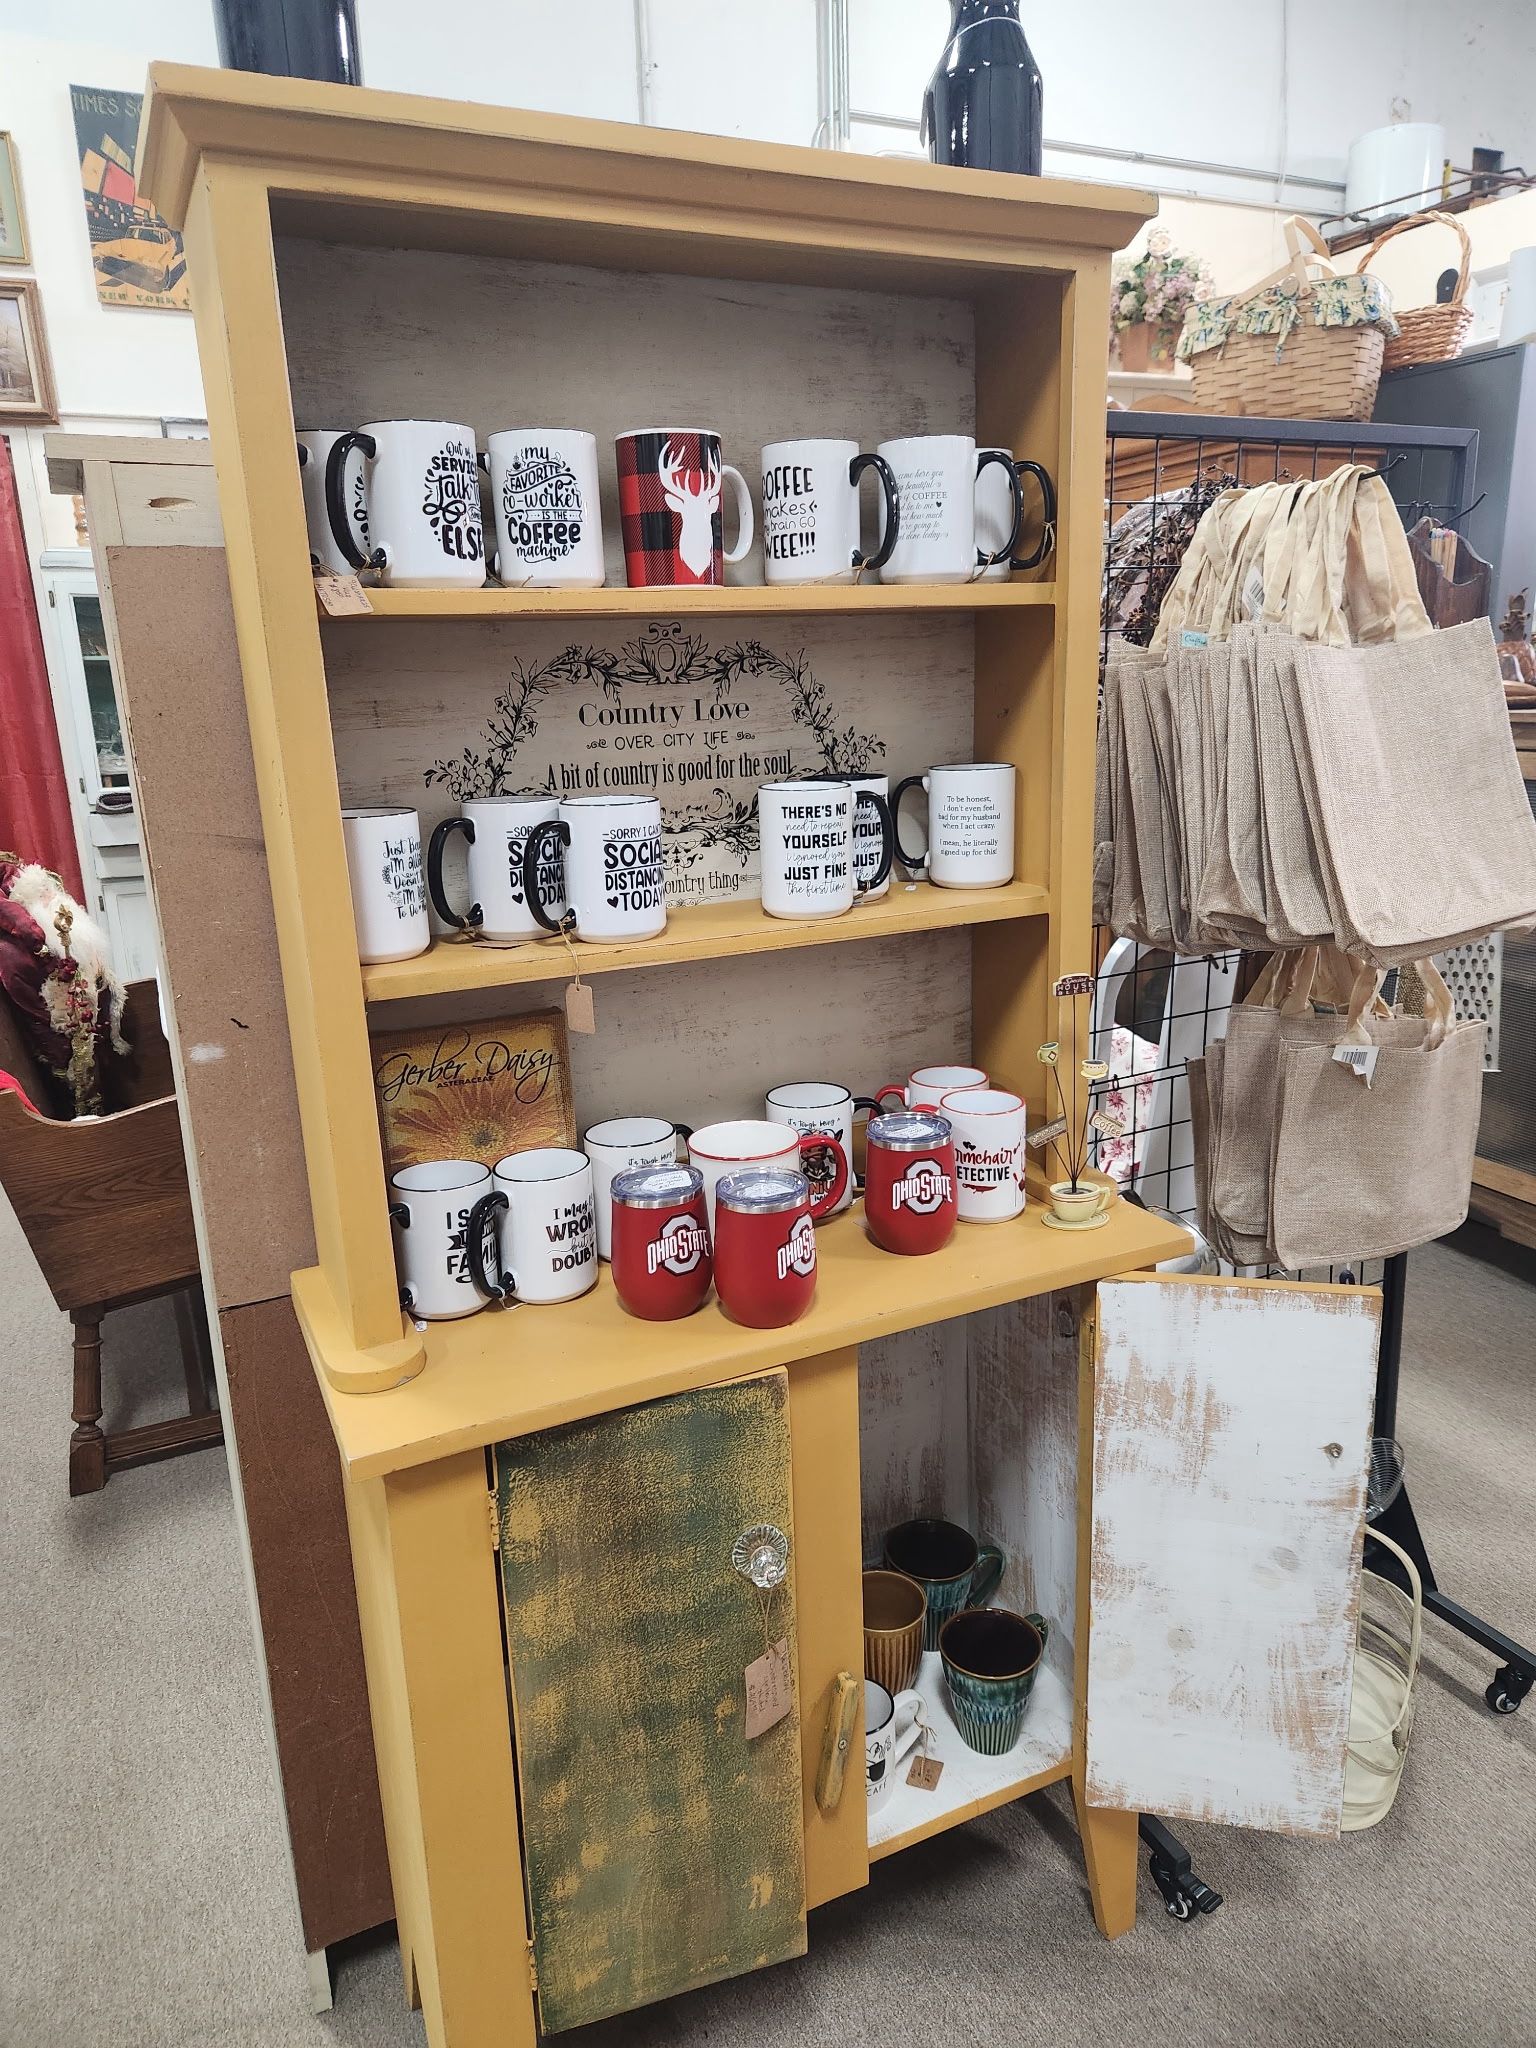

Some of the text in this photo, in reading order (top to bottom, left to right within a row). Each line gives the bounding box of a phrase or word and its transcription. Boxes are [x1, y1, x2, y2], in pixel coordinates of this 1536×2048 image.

[71, 93, 119, 115] TIMES
[99, 291, 128, 301] NEW
[136, 294, 177, 307] YORK
[510, 464, 562, 491] FAVORITE
[912, 491, 948, 501] COFFEE
[541, 511, 568, 520] IS THE
[771, 517, 797, 532] brain
[799, 516, 816, 529] GO
[516, 540, 571, 561] machine
[578, 698, 750, 729] Country Love
[614, 731, 728, 750] OVER CITY LIFE
[547, 764, 557, 792] A
[561, 763, 582, 790] bit
[585, 762, 600, 788] of
[603, 761, 659, 788] country
[662, 758, 674, 783] is
[678, 755, 713, 786] good
[716, 755, 735, 779] for
[739, 753, 761, 777] the
[781, 804, 832, 819] THERE'S
[836, 803, 847, 816] NO
[973, 812, 1000, 820] husband
[609, 827, 641, 840] SORRY
[643, 827, 647, 838] I
[786, 819, 809, 832] need
[809, 819, 818, 832] to
[782, 831, 847, 849] YOURSELF
[852, 851, 880, 867] JUST
[784, 862, 847, 880] JUST FINE
[664, 870, 739, 896] ountry thing
[786, 881, 804, 895] the
[1057, 981, 1094, 991] HOUSE
[1057, 988, 1094, 996] BLEND
[375, 1028, 560, 1104] Gerber Daisy
[1093, 1116, 1121, 1137] Coffee
[955, 1147, 1013, 1166] rmchair
[956, 1165, 1010, 1182] ETECTIVE
[446, 1211, 452, 1230] I
[552, 1207, 560, 1221] I
[551, 1242, 595, 1273] DOUBT
